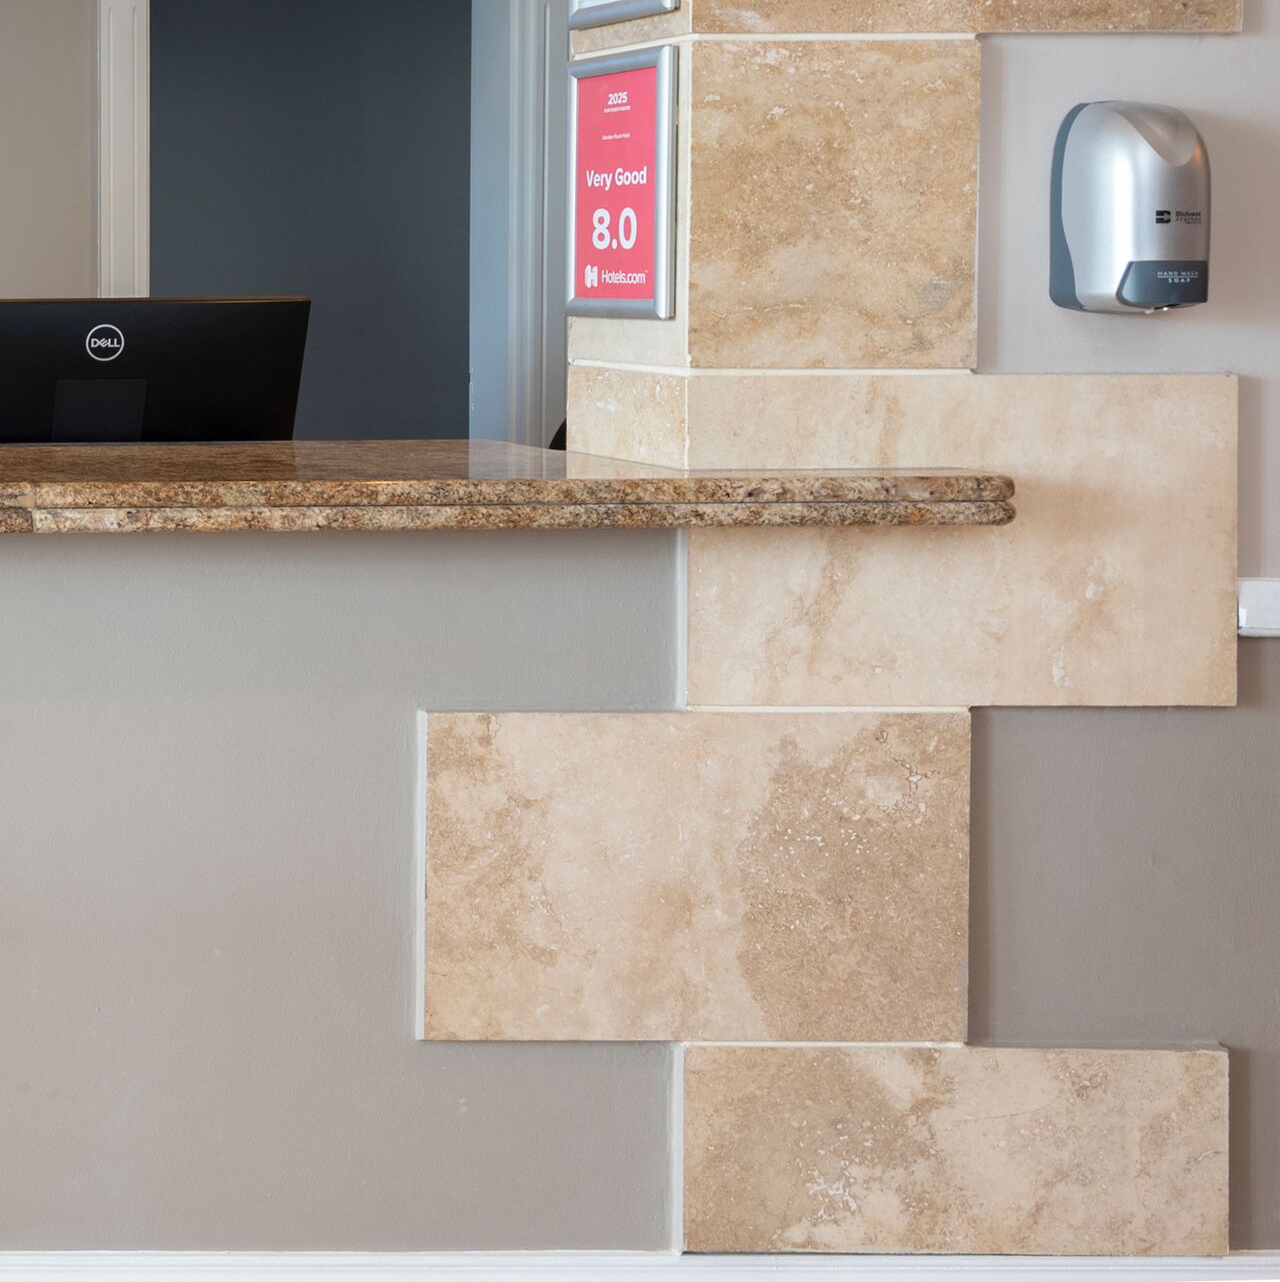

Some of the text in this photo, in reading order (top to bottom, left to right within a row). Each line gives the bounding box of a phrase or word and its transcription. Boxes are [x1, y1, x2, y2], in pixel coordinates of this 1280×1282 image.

[607, 91, 628, 105] 2025
[586, 166, 647, 191] Very Good
[592, 206, 638, 250] 8.0
[601, 269, 646, 285] Hotels.com
[90, 338, 121, 348] DELL
